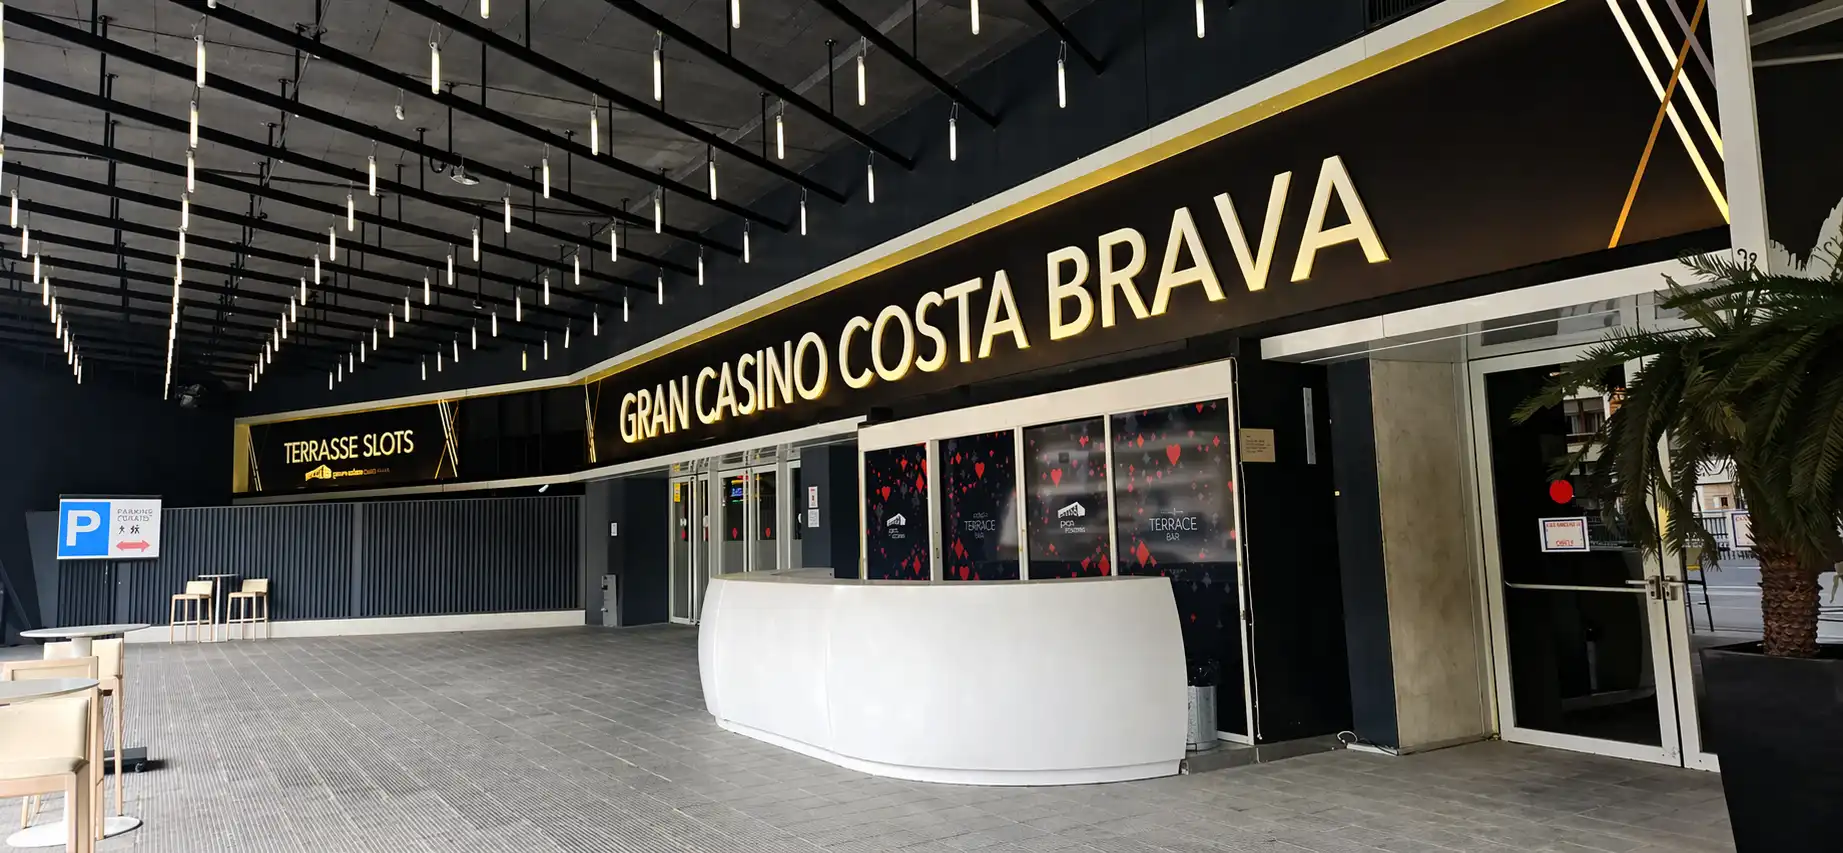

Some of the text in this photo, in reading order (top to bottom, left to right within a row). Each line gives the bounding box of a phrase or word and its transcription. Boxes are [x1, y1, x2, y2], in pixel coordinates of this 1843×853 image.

[620, 155, 1391, 444] GRAN CASINO COSTA BRAVA
[284, 430, 414, 464] TERRASSE SLOTS
[66, 509, 101, 547] P
[1149, 516, 1198, 531] TERRACE
